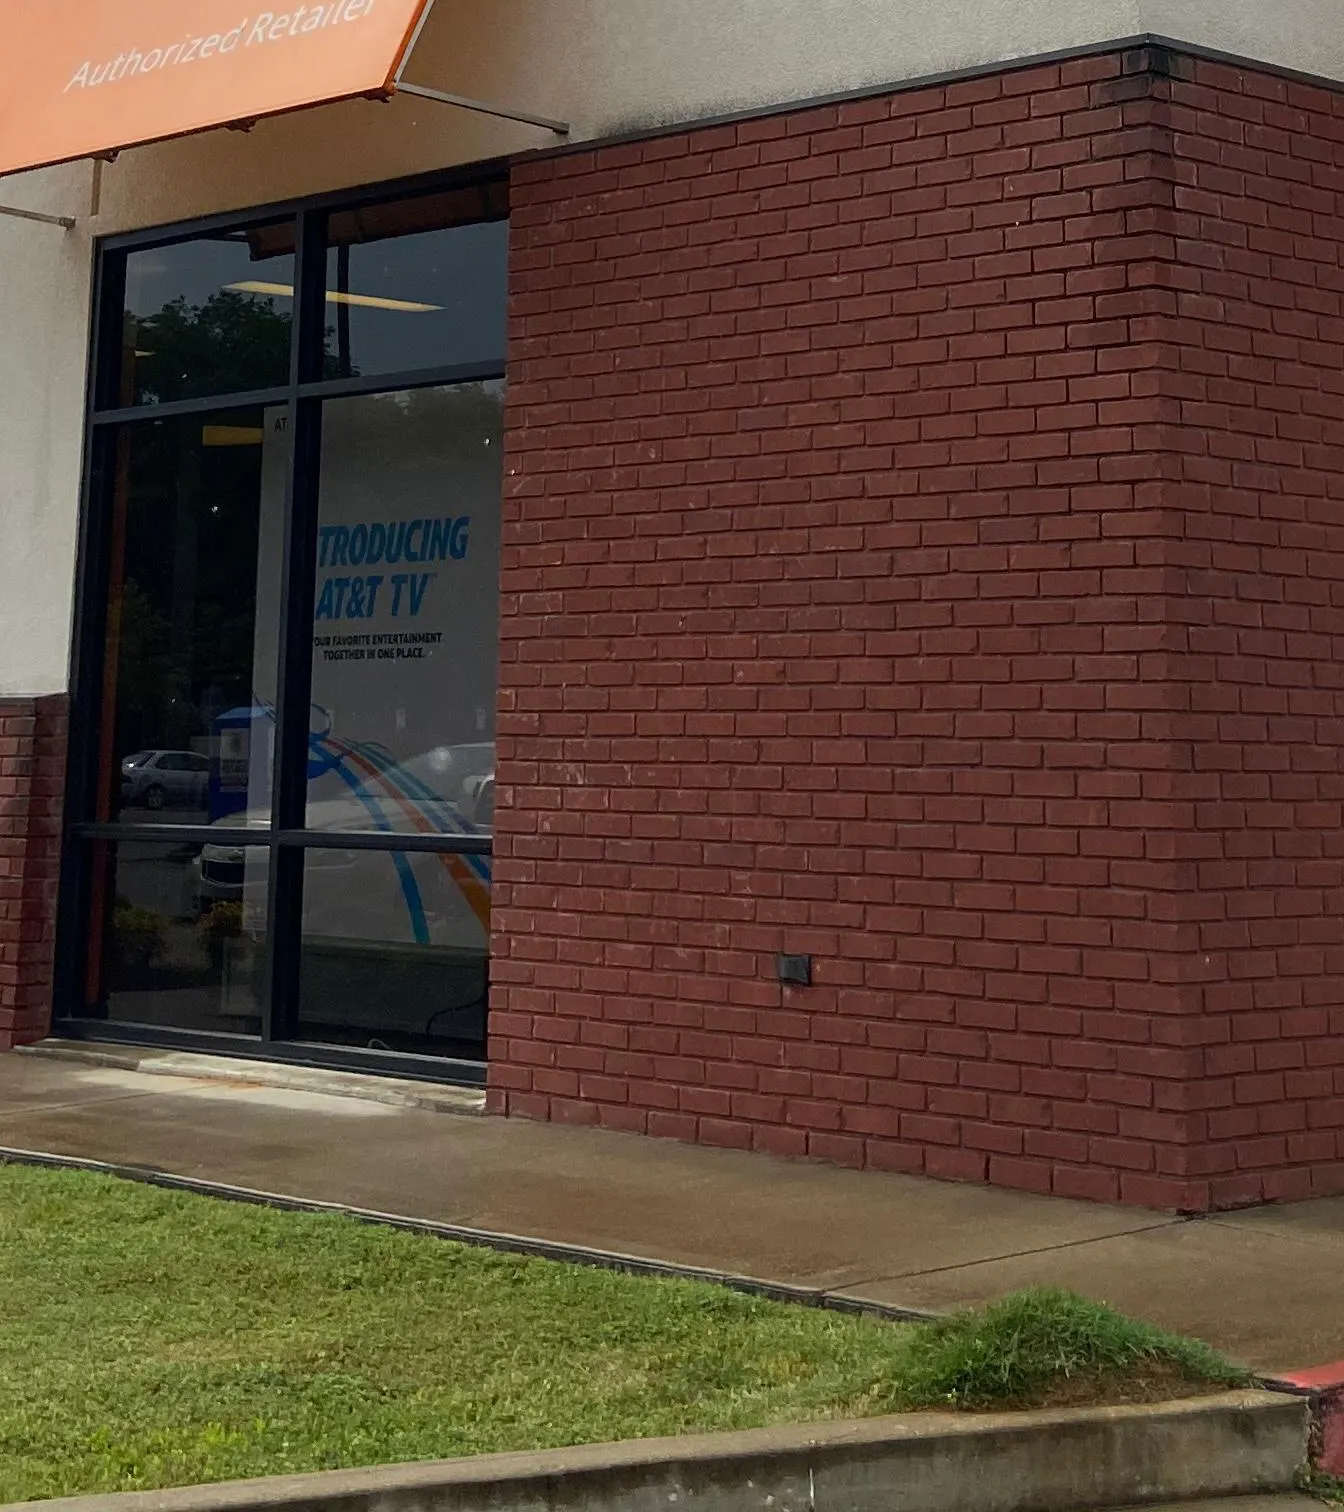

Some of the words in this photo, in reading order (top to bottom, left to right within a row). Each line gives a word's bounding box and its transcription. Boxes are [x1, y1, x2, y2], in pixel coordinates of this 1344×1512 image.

[64, 19, 247, 92] Authorized
[273, 417, 290, 433] AT
[318, 515, 472, 568] TRODUCING
[314, 575, 384, 620] AT&T
[313, 635, 331, 647] OUR
[332, 634, 371, 646] FAVORITE
[372, 632, 443, 645] ENTERTAINMENT
[323, 649, 365, 661] TOGETHER
[366, 650, 376, 660] IN
[377, 648, 395, 659] ONE
